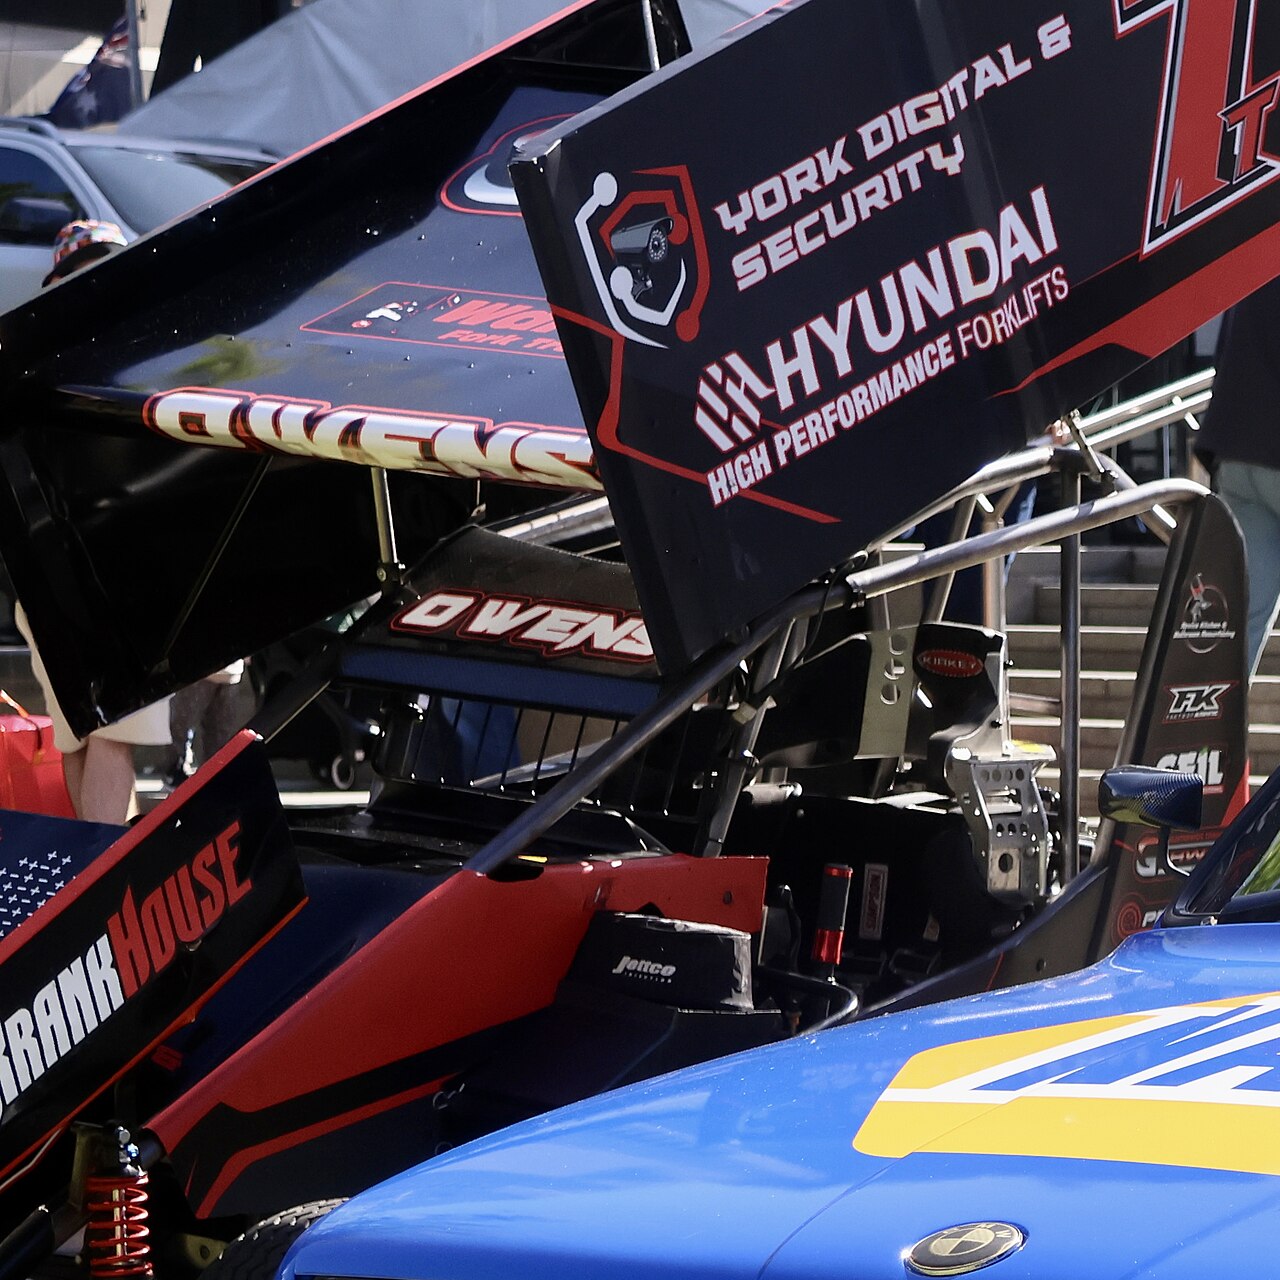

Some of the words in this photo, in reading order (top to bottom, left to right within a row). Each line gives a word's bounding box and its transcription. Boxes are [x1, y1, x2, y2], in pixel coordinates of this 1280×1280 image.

[714, 137, 852, 235] YORK
[857, 43, 1031, 160] DIGITAL
[1037, 14, 1073, 62] &
[731, 132, 966, 292] SECURITY
[706, 432, 771, 506] HIGH
[776, 338, 956, 461] PERFORMANCE
[959, 267, 1070, 360] FORKLIFTS
[769, 185, 1060, 411] HYUNDAI
[398, 591, 655, 658] OWENS
[1170, 684, 1229, 714] FK
